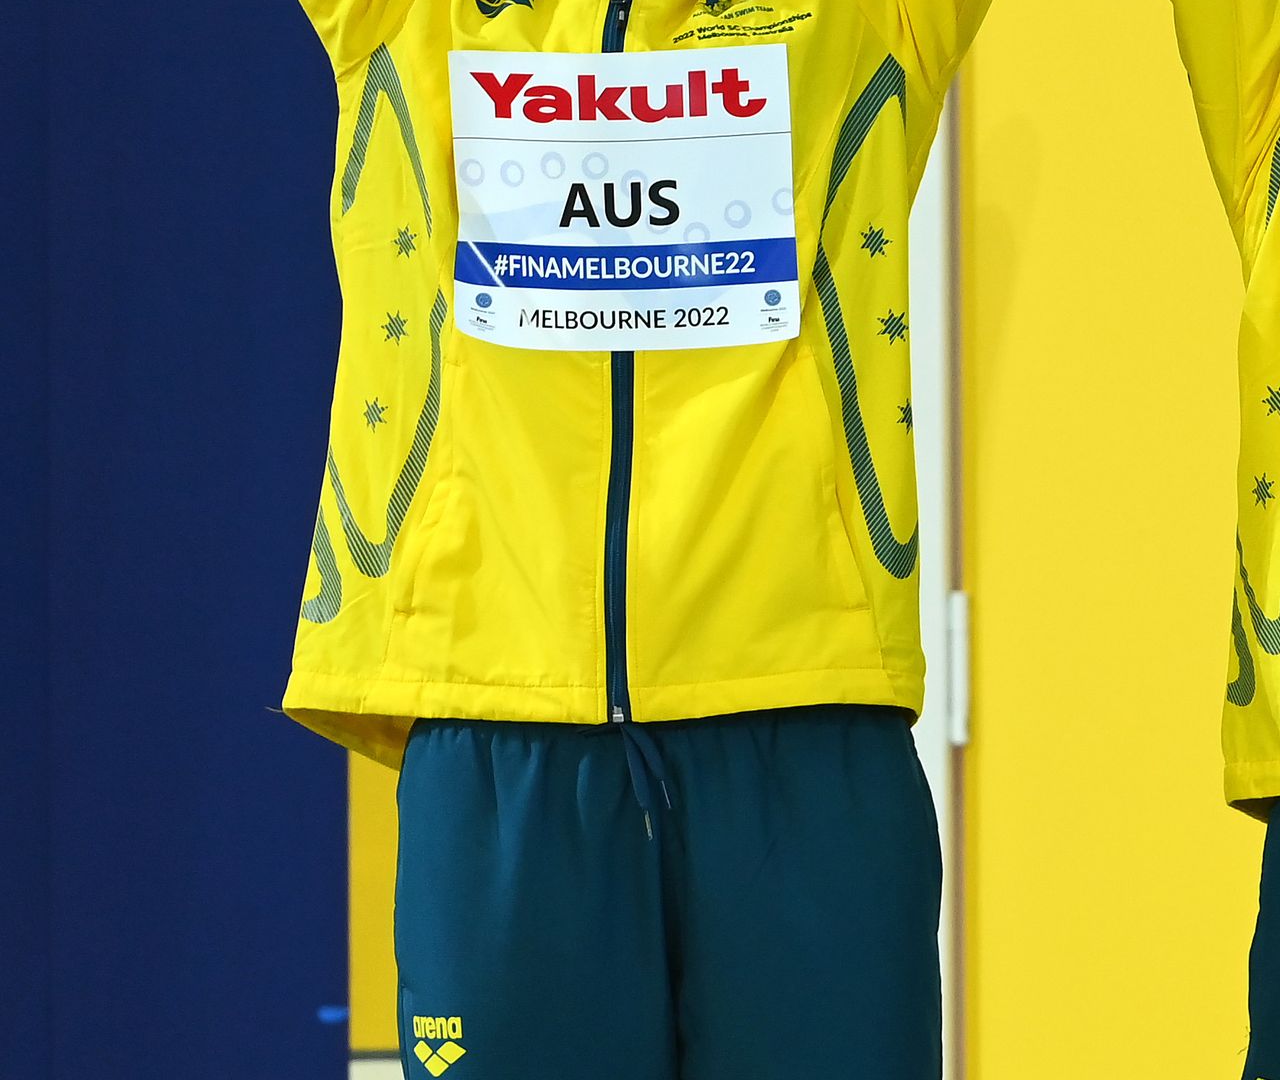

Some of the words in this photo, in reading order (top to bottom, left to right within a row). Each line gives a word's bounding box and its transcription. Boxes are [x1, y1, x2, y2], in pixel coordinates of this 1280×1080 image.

[672, 30, 695, 44] 2022
[697, 23, 726, 34] World
[470, 68, 767, 124] Yakult
[559, 179, 680, 228] AUS
[494, 250, 756, 280] #FINAMELBOURNE22
[518, 307, 667, 330] MELBOURNE
[673, 306, 730, 328] 2022
[413, 1015, 463, 1039] arena
